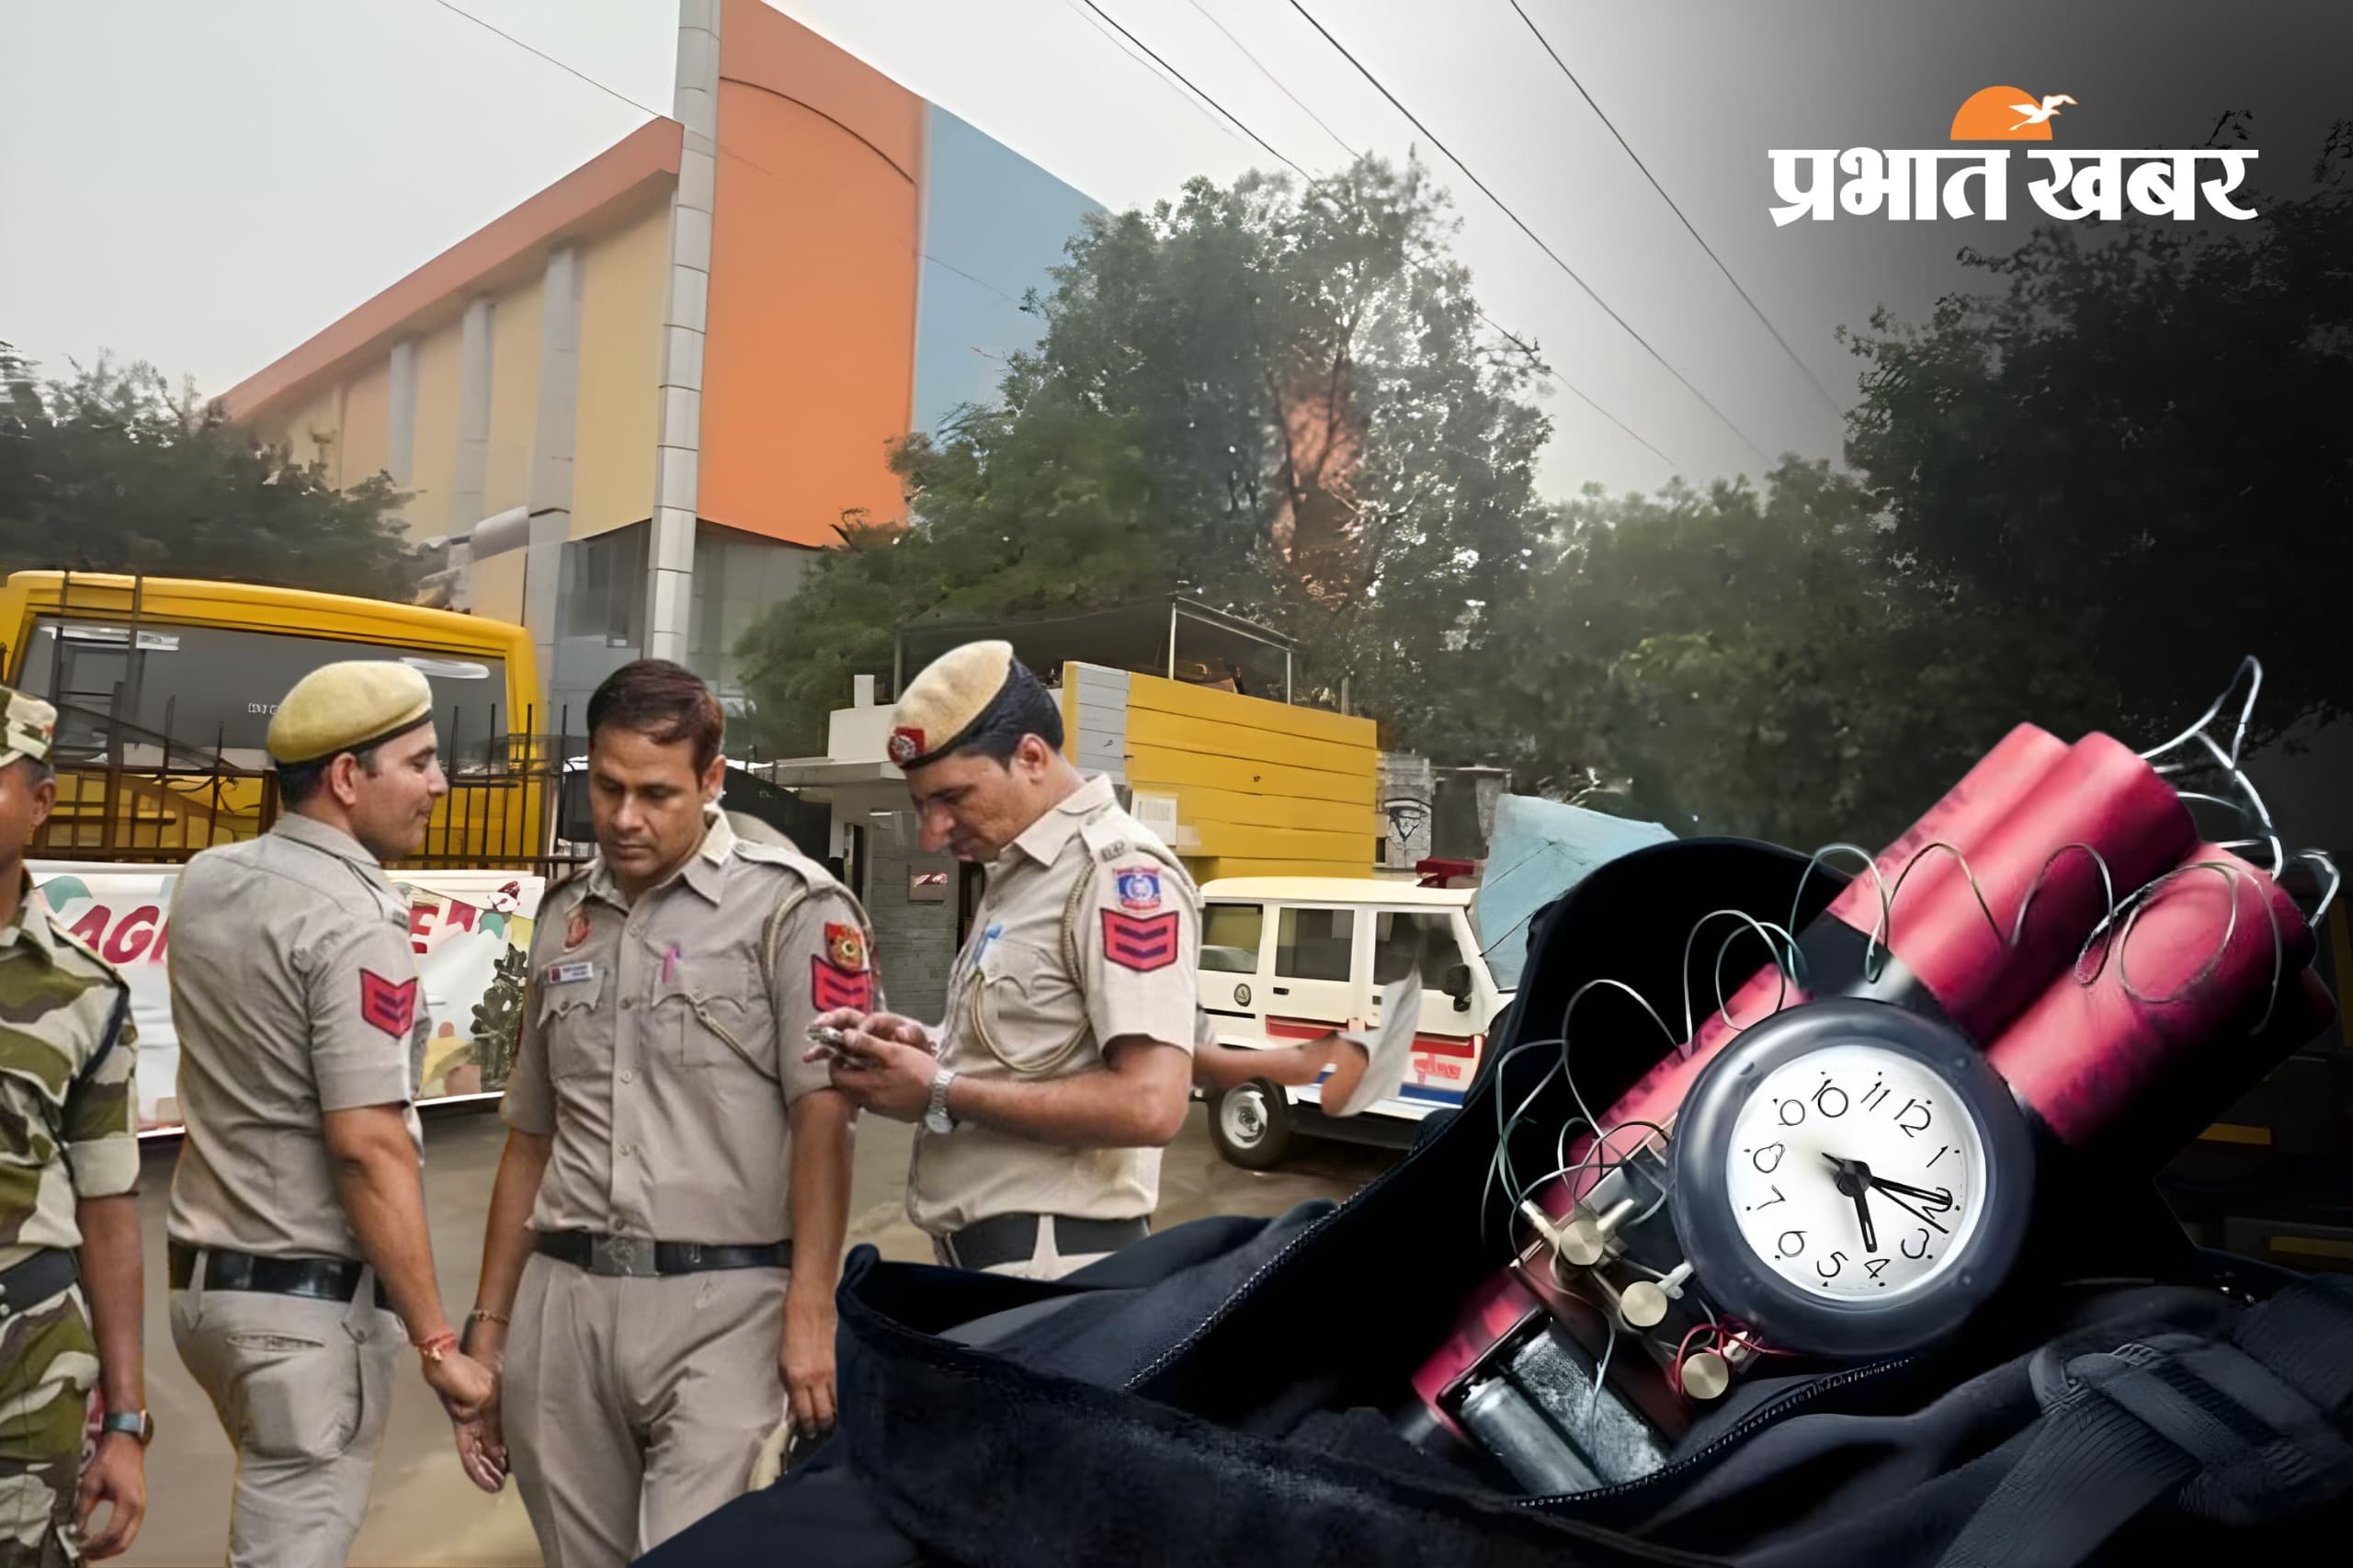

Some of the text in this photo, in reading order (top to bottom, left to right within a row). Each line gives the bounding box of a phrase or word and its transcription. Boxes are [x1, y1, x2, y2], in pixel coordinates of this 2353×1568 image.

[1811, 1078, 1849, 1119] 10
[1860, 1081, 1891, 1112] 11
[1893, 1098, 1931, 1138] 12
[1926, 1145, 1949, 1168] 1
[1756, 1184, 1786, 1210] 7
[1901, 1228, 1929, 1259] 3
[1816, 1251, 1849, 1278] 5
[1863, 1258, 1891, 1279] 4
